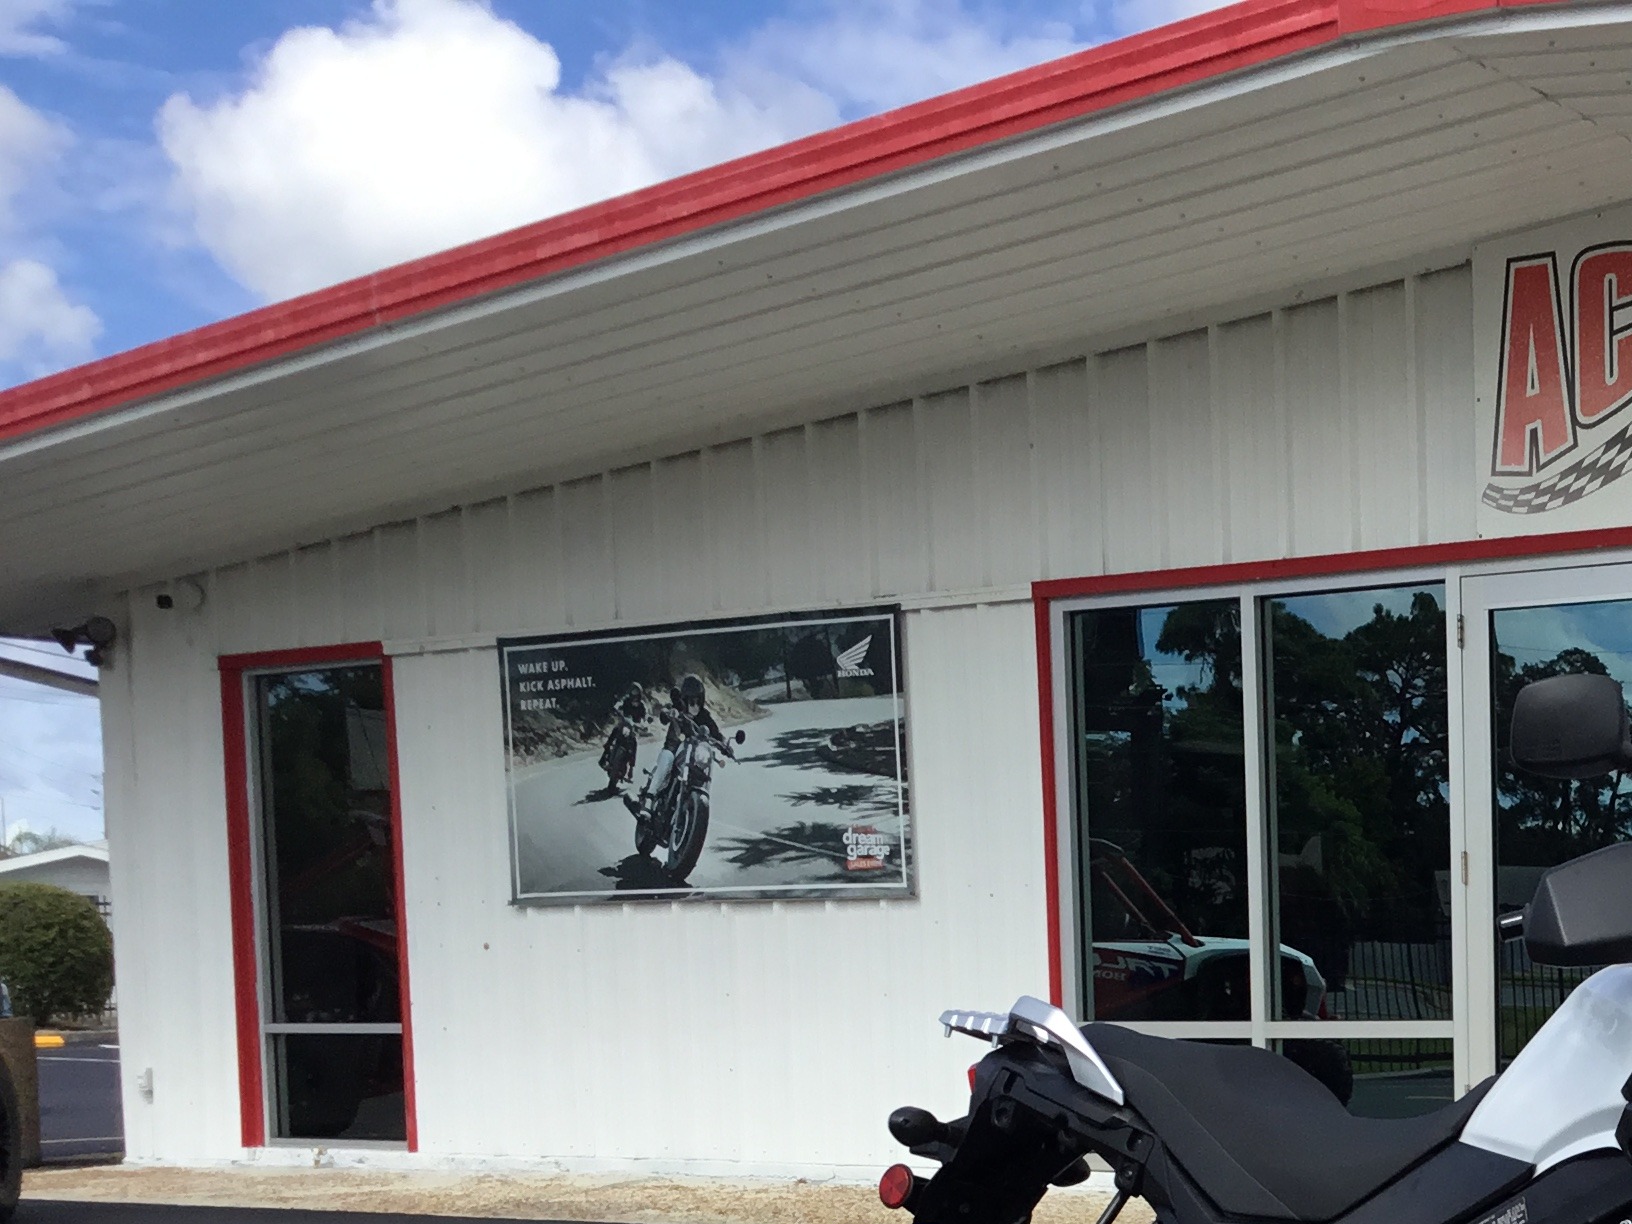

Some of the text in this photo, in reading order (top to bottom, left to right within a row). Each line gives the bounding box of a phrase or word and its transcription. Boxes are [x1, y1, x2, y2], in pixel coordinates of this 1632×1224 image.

[517, 660, 569, 674] WAKE UP.
[837, 668, 875, 678] HONDA
[519, 676, 596, 692] KICK ASPHALT.
[520, 697, 560, 711] REPEAT.
[842, 827, 884, 845] dream
[847, 844, 890, 860] garage
